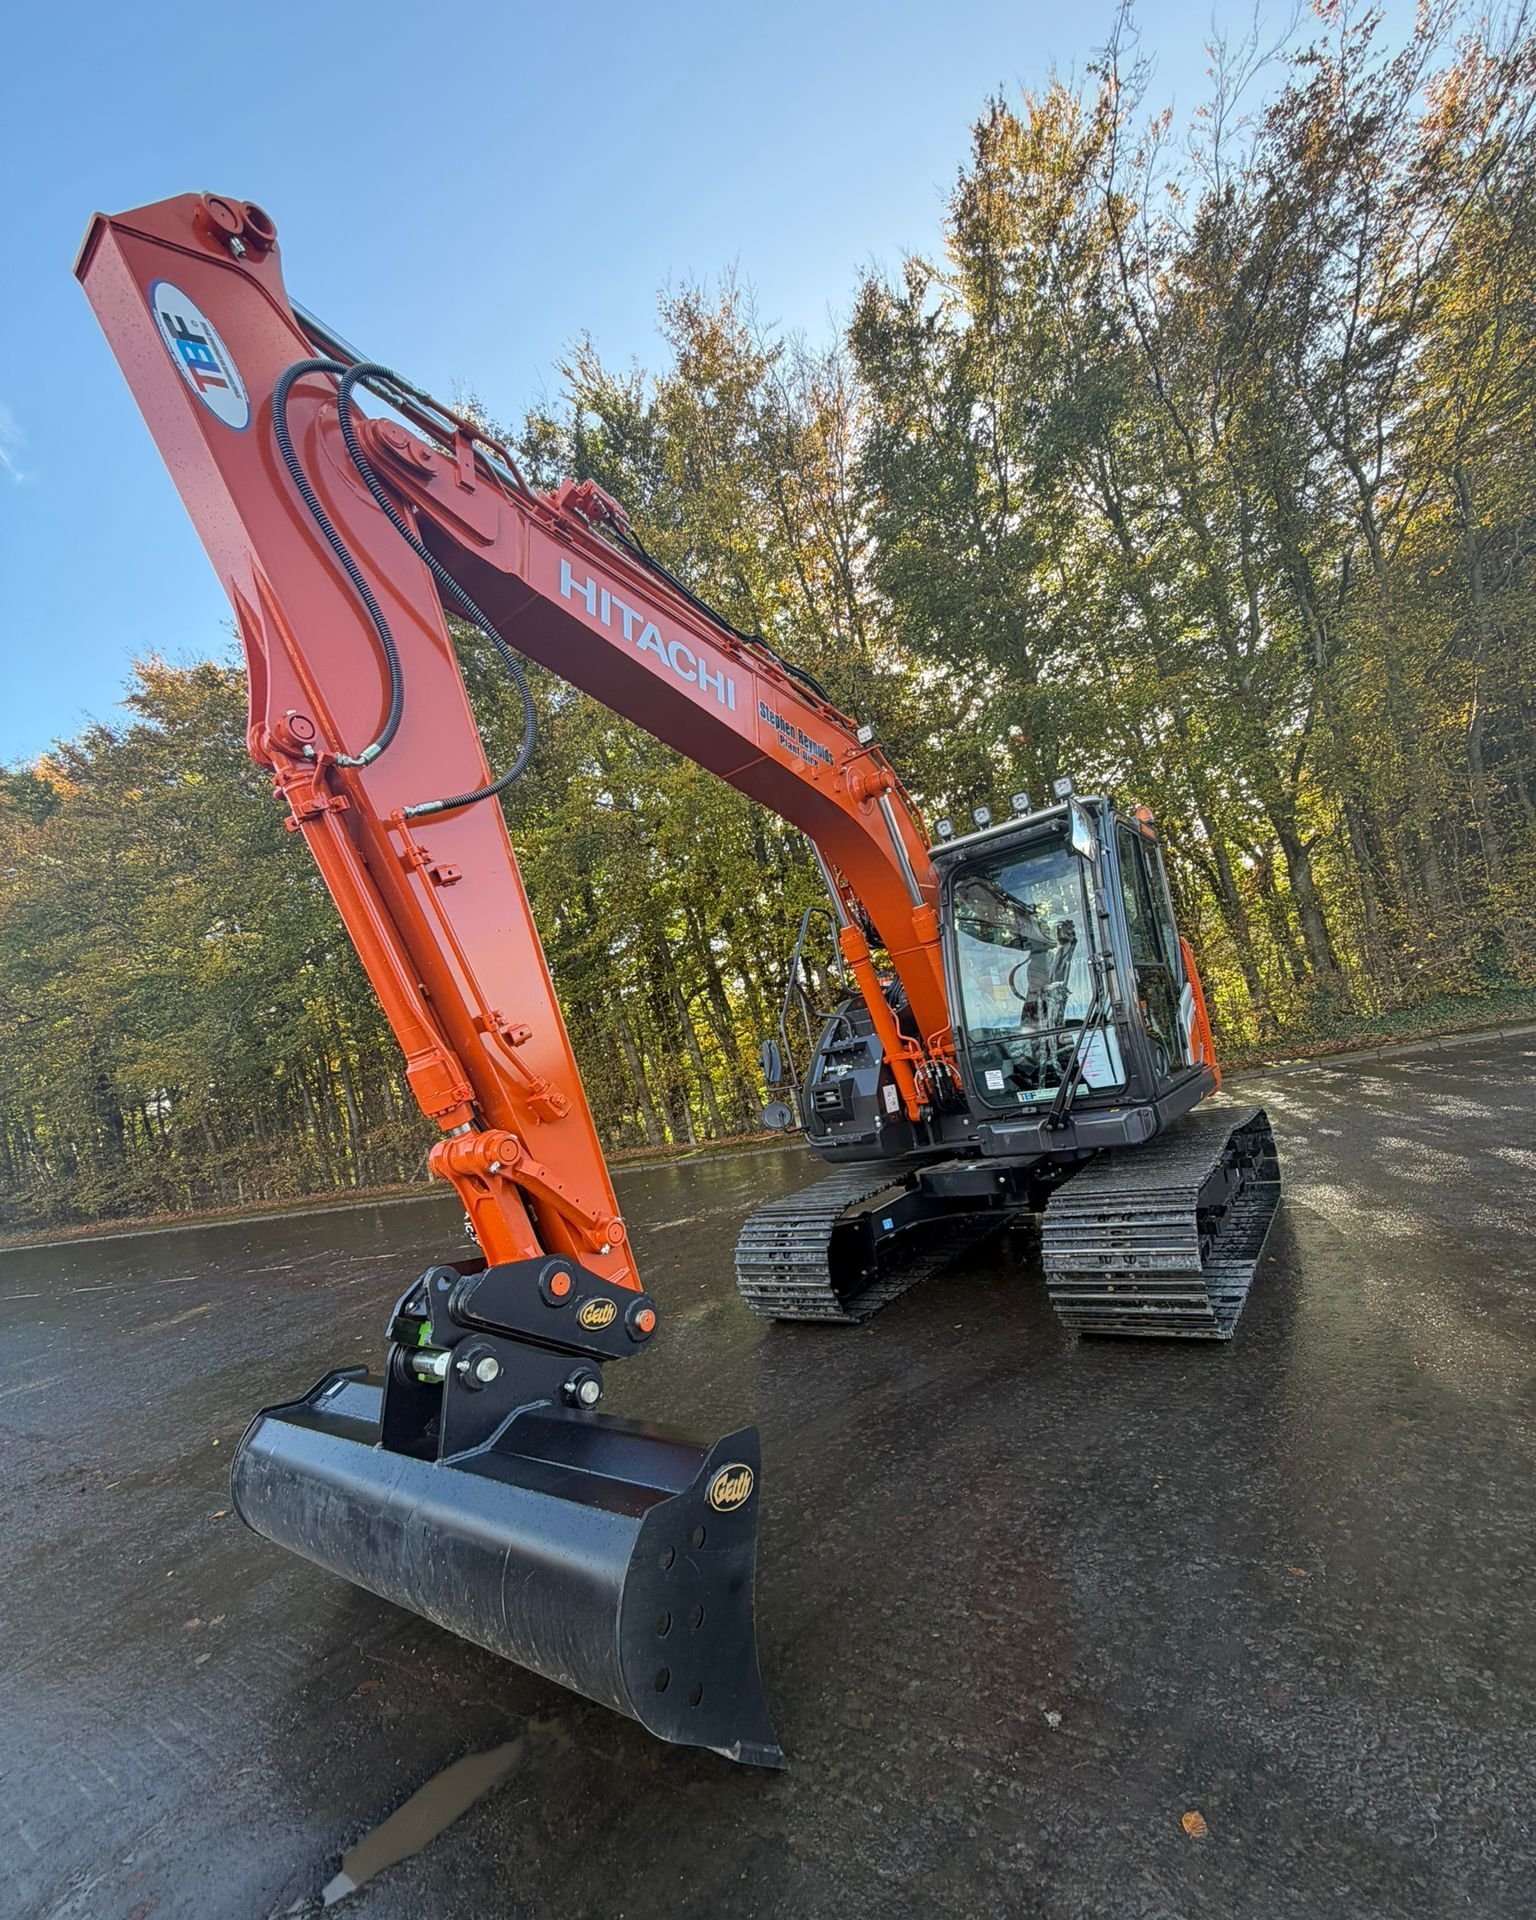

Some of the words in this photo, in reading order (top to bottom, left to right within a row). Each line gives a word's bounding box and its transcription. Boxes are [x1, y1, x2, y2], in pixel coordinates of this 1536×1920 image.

[161, 312, 229, 393] TBF
[560, 558, 736, 711] HITACHI
[759, 700, 796, 741] Stephen
[796, 727, 834, 767] Reynolds
[779, 735, 800, 757] Plant
